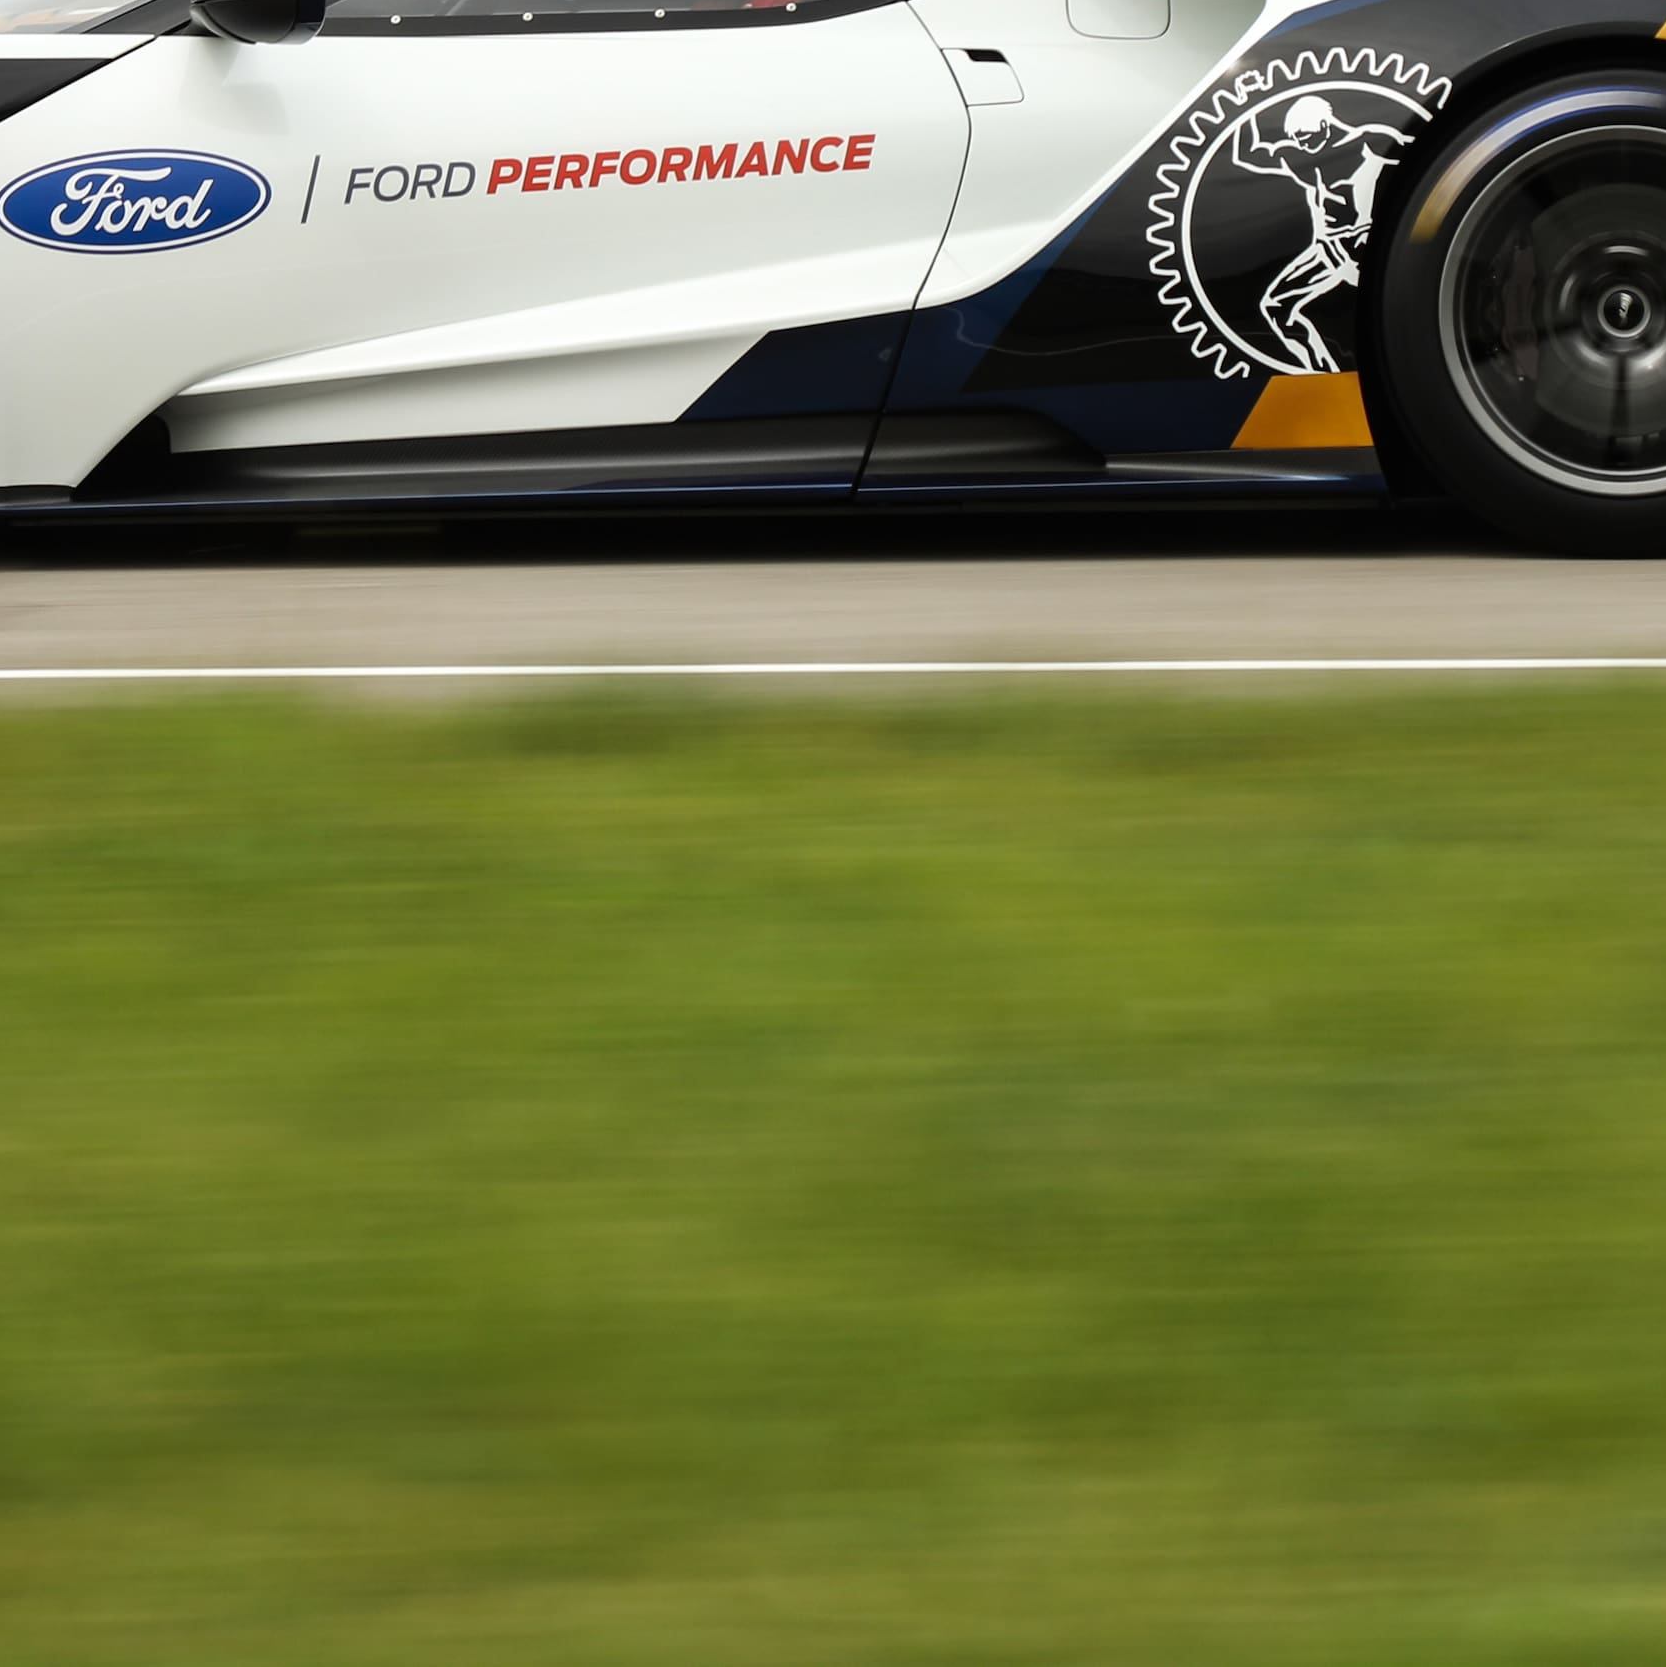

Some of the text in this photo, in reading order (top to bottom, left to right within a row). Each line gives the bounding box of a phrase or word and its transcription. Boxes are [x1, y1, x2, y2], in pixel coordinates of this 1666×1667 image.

[50, 166, 214, 236] Ford
[344, 134, 875, 204] FORD PERFORMANCE
